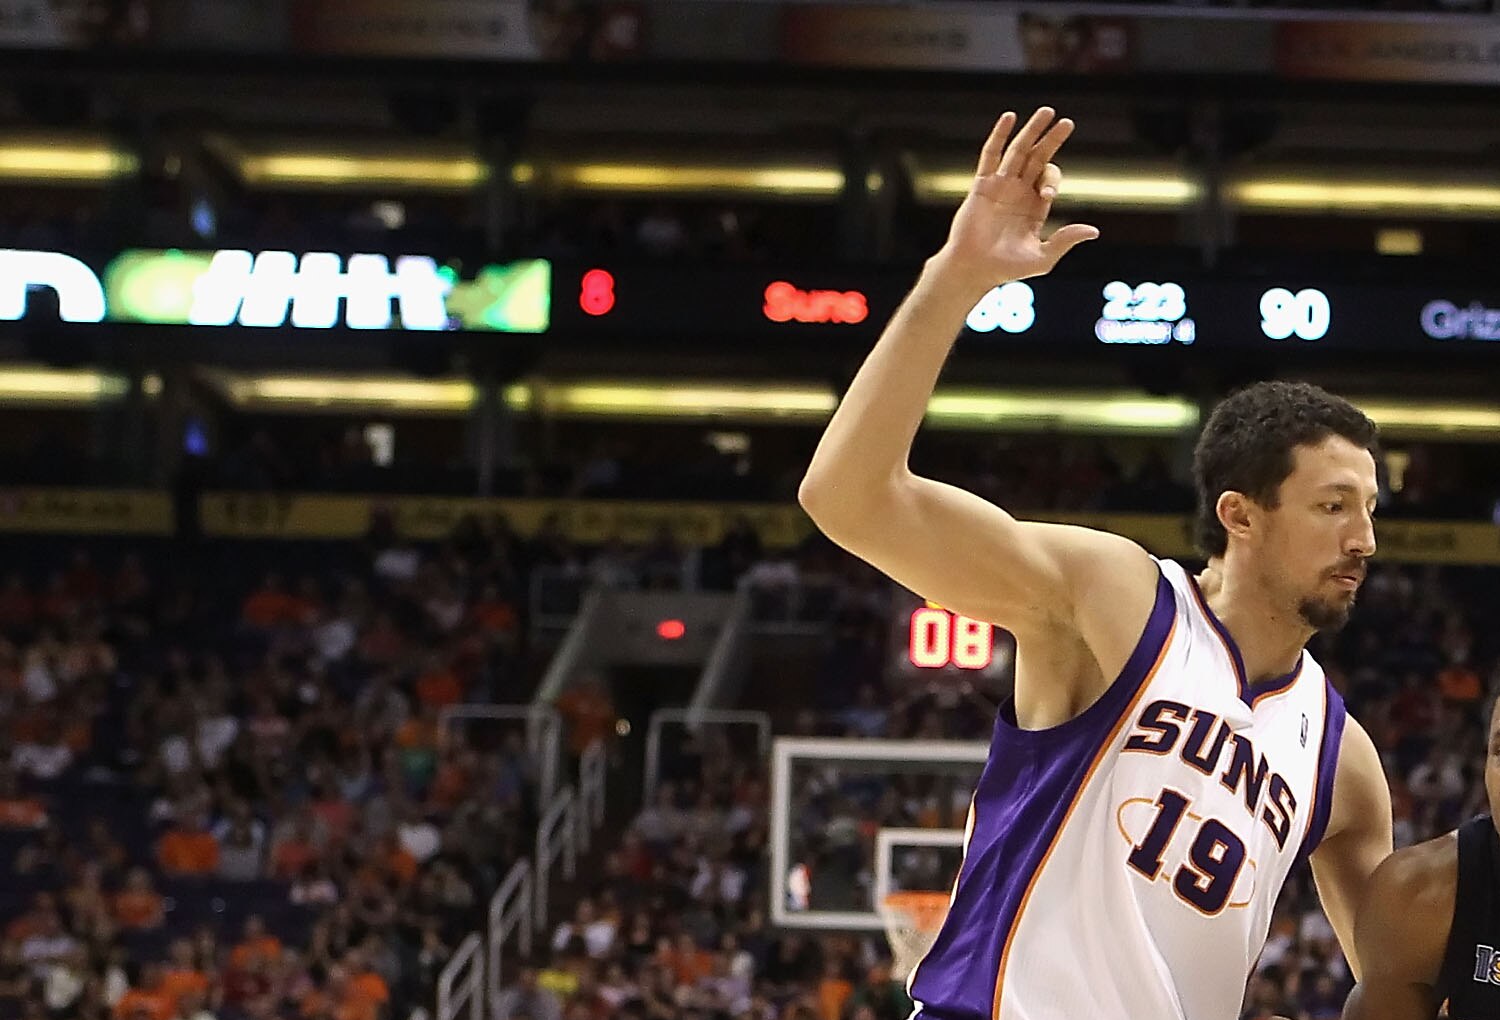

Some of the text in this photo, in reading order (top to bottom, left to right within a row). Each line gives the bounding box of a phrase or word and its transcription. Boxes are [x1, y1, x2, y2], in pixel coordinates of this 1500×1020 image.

[580, 269, 615, 315] 8
[763, 281, 868, 324] Suns
[1259, 287, 1331, 339] 90
[909, 607, 994, 669] 08
[1120, 699, 1297, 853] SUNS
[1126, 786, 1249, 917] 19
